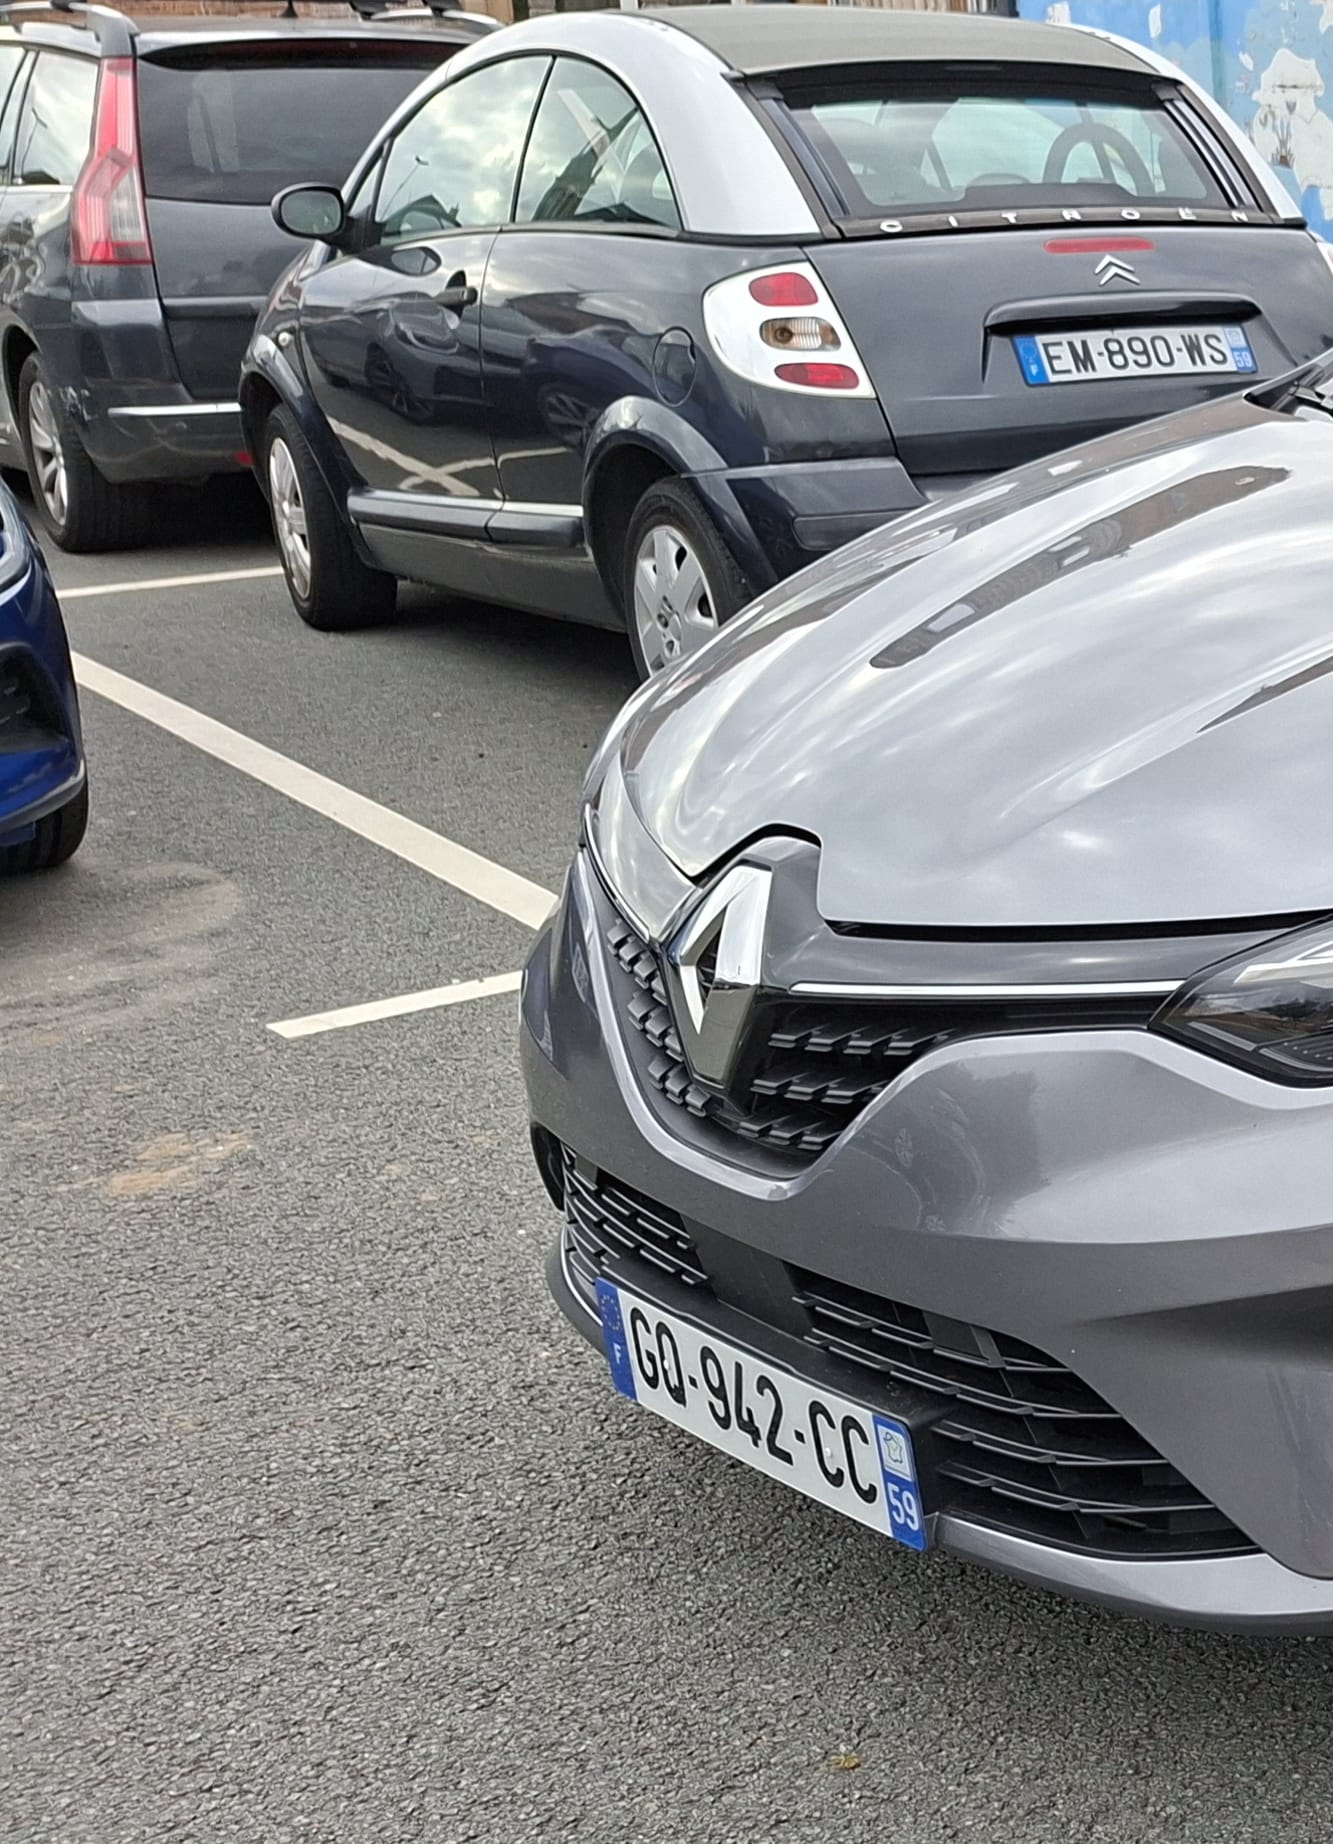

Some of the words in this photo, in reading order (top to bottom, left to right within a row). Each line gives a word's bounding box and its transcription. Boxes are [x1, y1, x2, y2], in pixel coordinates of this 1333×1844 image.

[1042, 333, 1229, 376] EM-890-WS
[1233, 350, 1254, 369] 59
[613, 1342, 623, 1365] F
[630, 1306, 878, 1504] GQ-942-CC
[888, 1482, 920, 1531] 59
